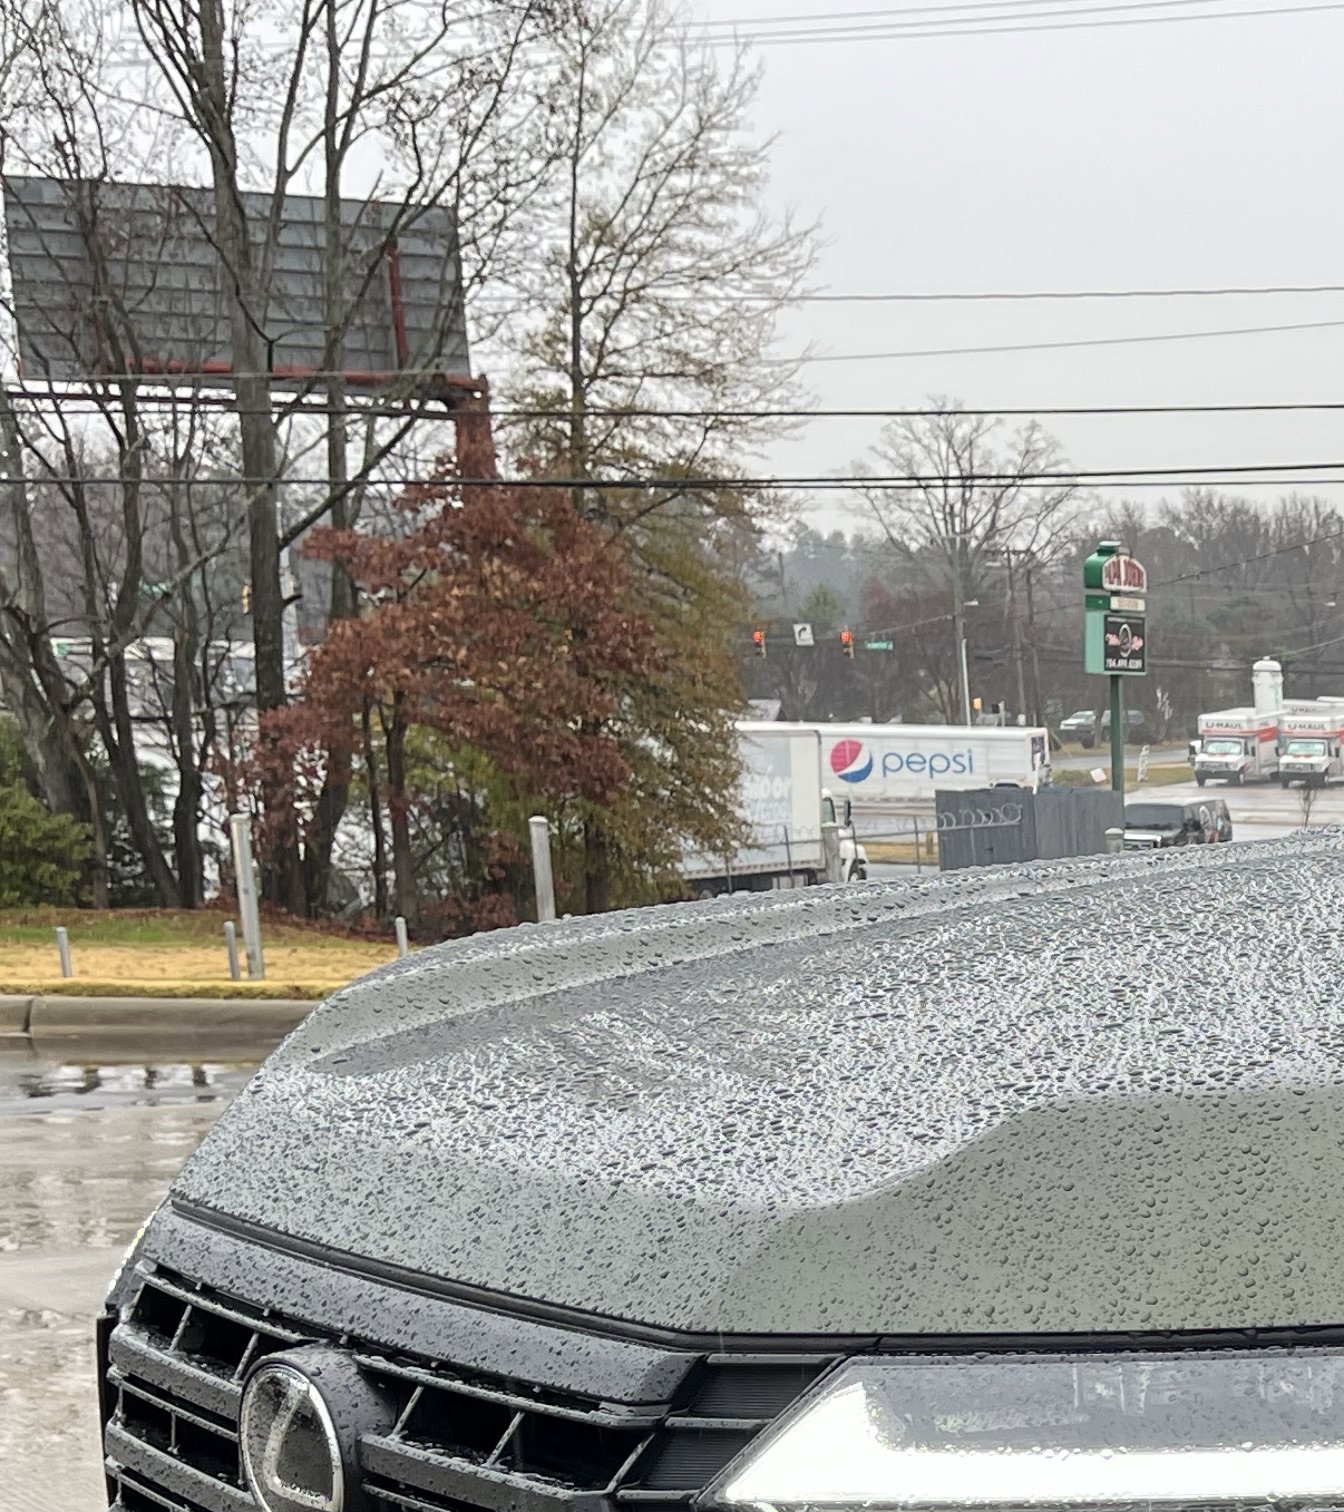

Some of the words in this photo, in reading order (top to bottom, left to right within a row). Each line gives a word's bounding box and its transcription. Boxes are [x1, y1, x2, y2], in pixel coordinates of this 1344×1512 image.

[1205, 721, 1244, 729] U-HAUL
[1287, 722, 1326, 730] U-HAUL
[882, 748, 974, 779] pepsi
